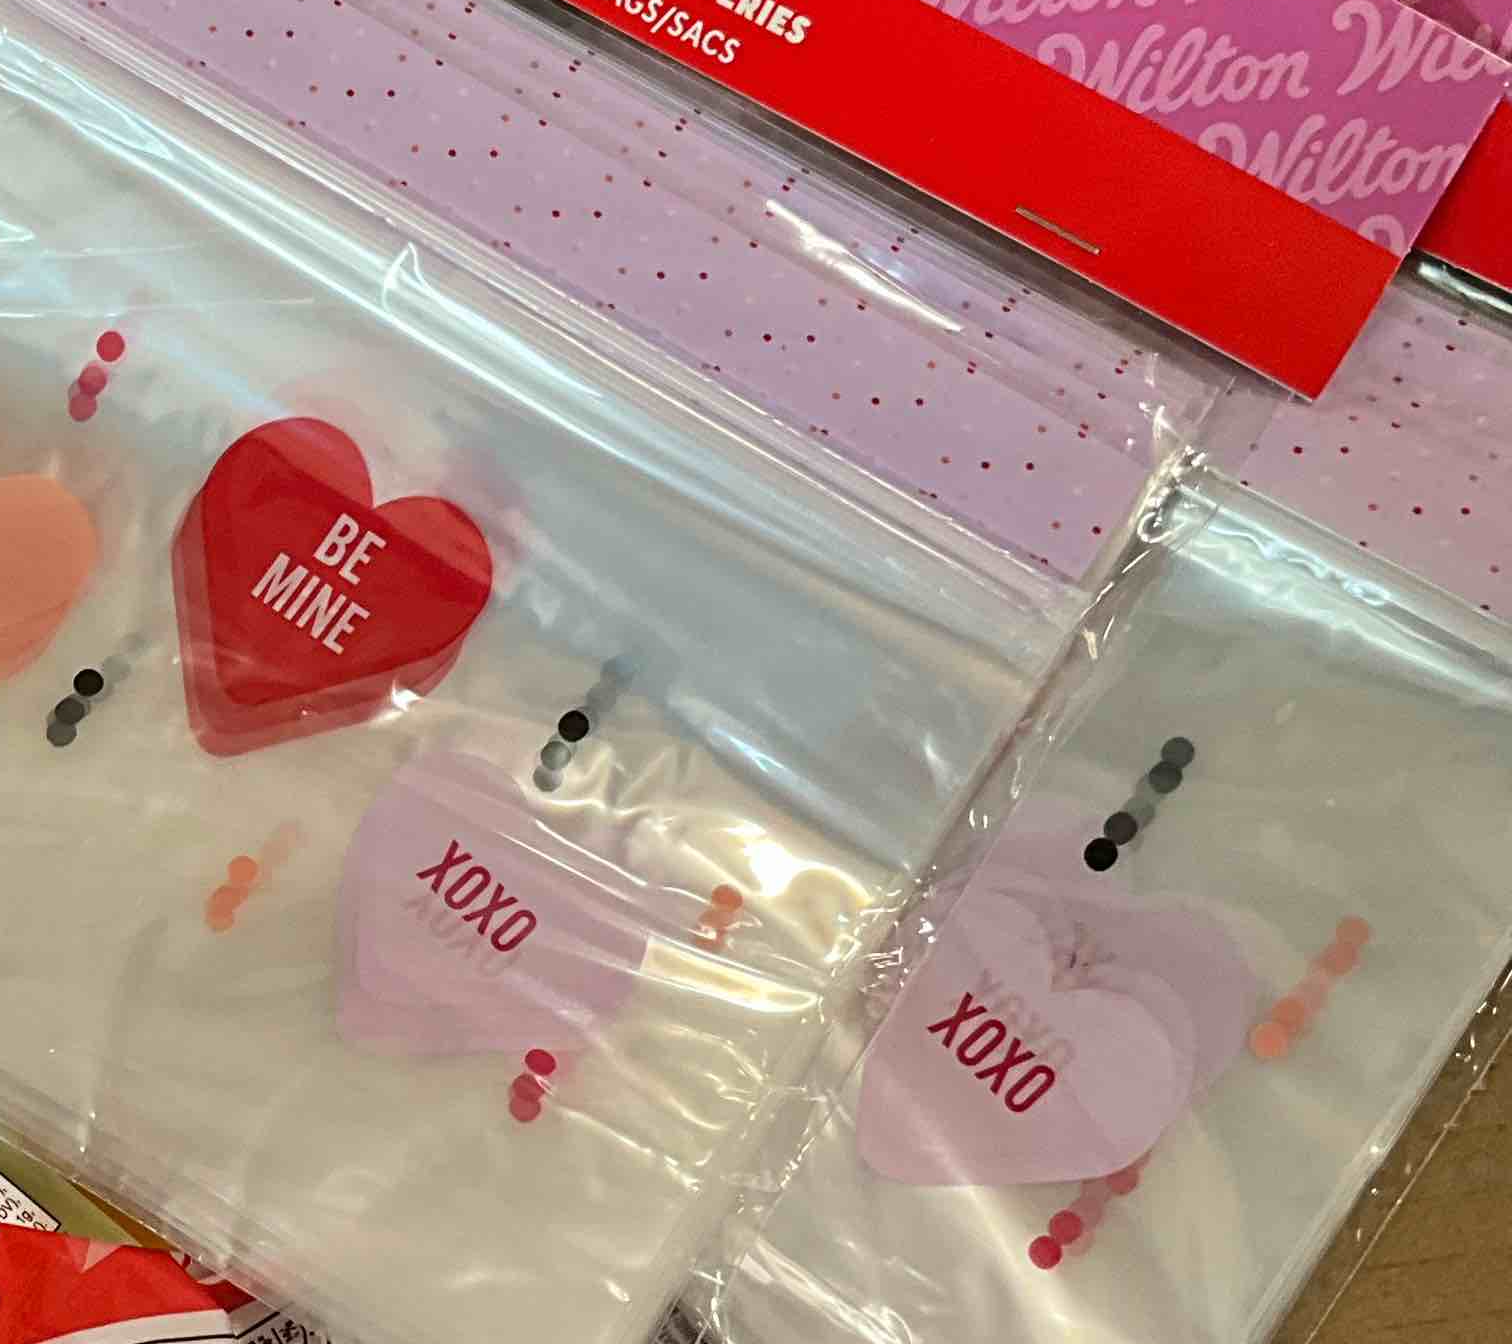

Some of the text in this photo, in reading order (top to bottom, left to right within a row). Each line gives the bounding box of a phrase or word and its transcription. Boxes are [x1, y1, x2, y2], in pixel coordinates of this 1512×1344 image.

[1037, 25, 1309, 114] Wilton
[313, 513, 386, 585] BE
[250, 554, 371, 655] MINE
[417, 840, 538, 951] XOXO
[927, 991, 1056, 1114] XOXO
